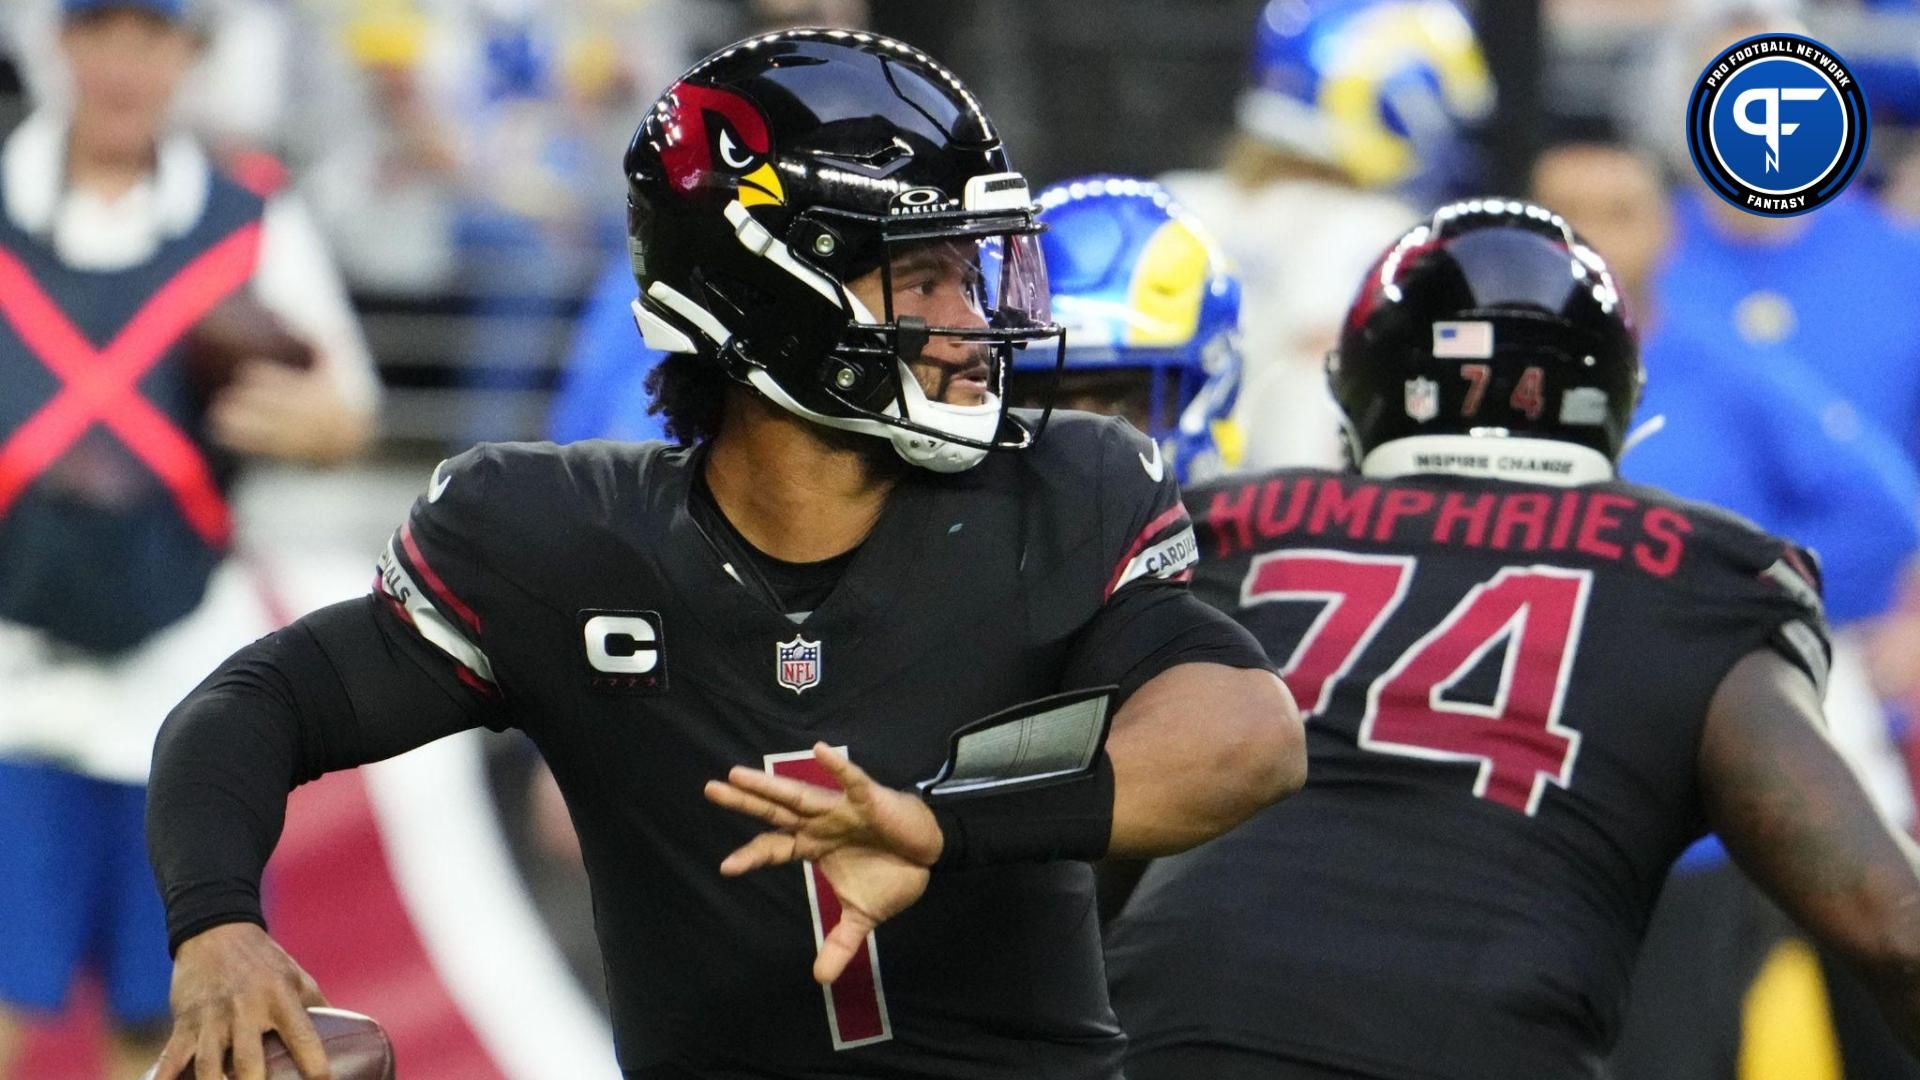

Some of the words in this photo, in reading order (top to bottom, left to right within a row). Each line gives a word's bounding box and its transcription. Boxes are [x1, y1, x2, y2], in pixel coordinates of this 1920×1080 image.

[891, 203, 949, 216] OAKLEY
[1208, 479, 1694, 577] HUMPHRIES
[584, 615, 658, 674] C
[784, 661, 814, 684] NFL
[1240, 548, 1594, 818] 74
[763, 745, 893, 1052] 1
